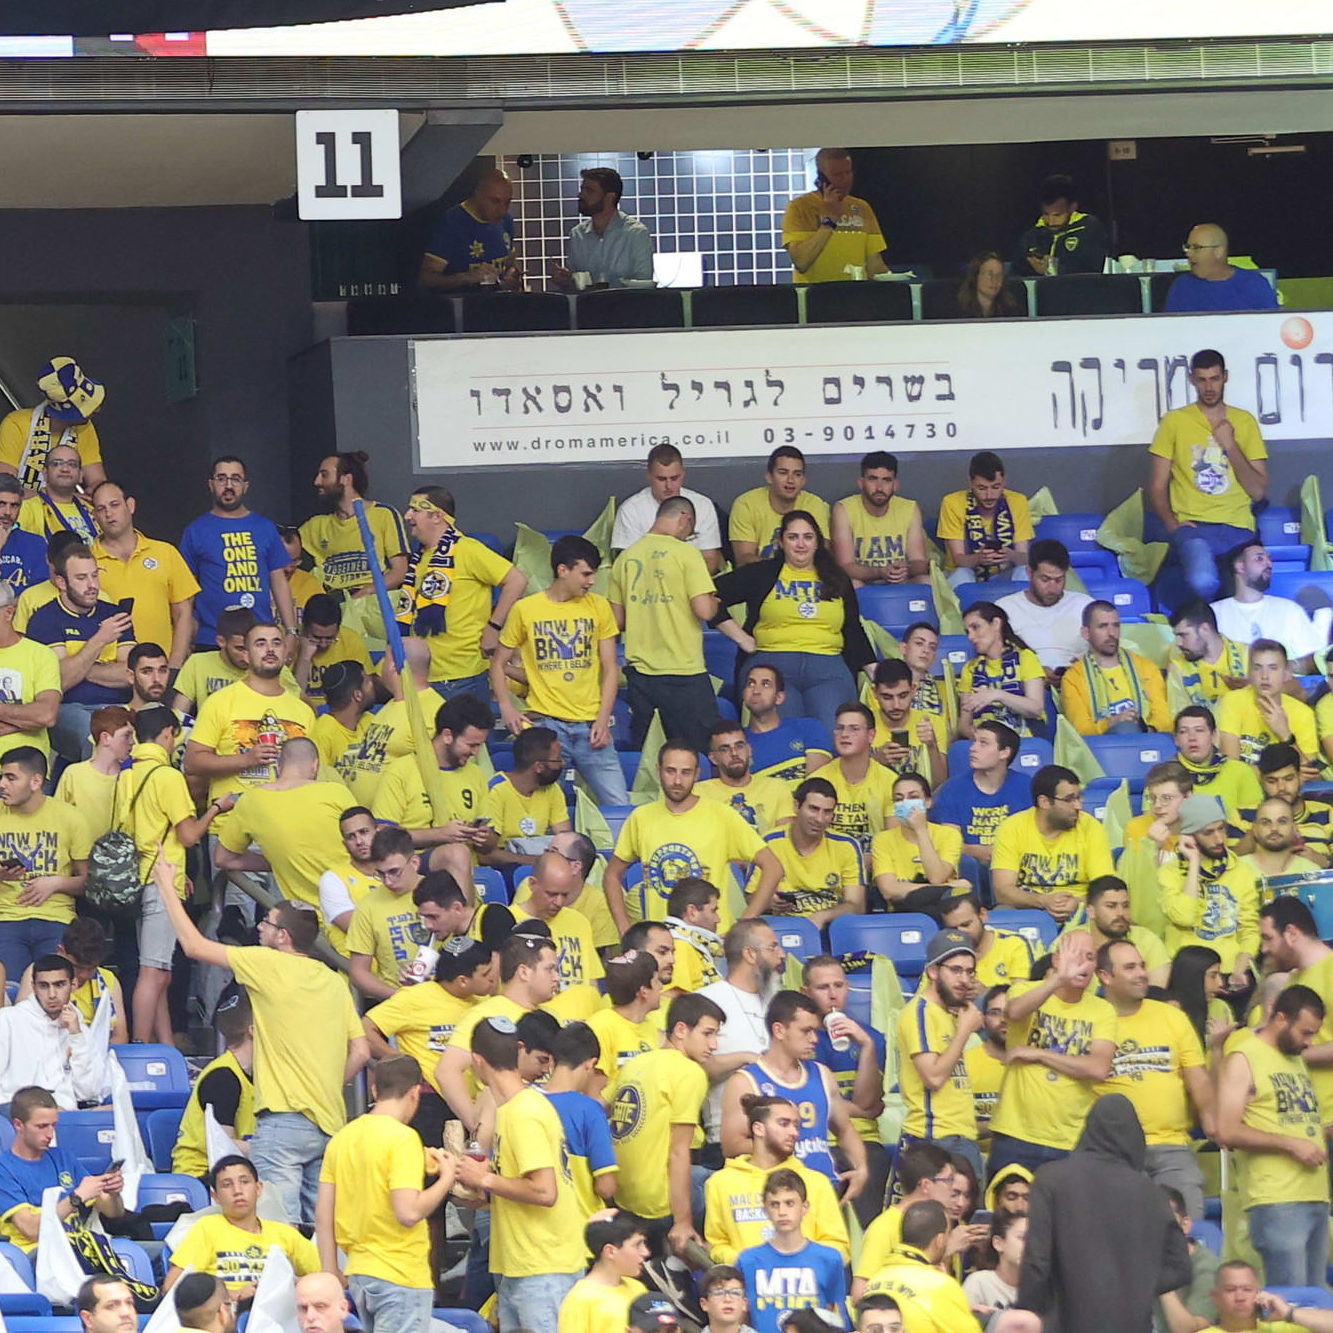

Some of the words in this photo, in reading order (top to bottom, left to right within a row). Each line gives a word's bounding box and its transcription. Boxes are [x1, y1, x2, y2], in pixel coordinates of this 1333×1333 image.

[314, 131, 384, 198] 11
[660, 369, 785, 410] לגריל
[823, 371, 956, 406] בשרים
[1051, 355, 1191, 437] מריקה
[469, 383, 626, 417] ואסאדו
[473, 431, 730, 453] www.dromamerica.co.il
[763, 422, 958, 445] 03-9014730
[221, 532, 253, 547] THE
[855, 537, 863, 559] I
[866, 535, 905, 559] AM
[223, 547, 257, 562] ONE
[226, 563, 258, 577] AND
[223, 577, 263, 592] ONLY.
[533, 619, 567, 636] NOW
[573, 617, 594, 633] I'M
[535, 635, 593, 661] BACK
[461, 788, 473, 809] 9
[837, 802, 866, 813] THEN
[972, 804, 1009, 816] WORK
[35, 831, 58, 848] I'M
[967, 825, 997, 836] DREA
[557, 935, 581, 952] I'M
[559, 955, 584, 979] CK
[798, 1101, 816, 1128] 9
[755, 1267, 818, 1297] MTA
